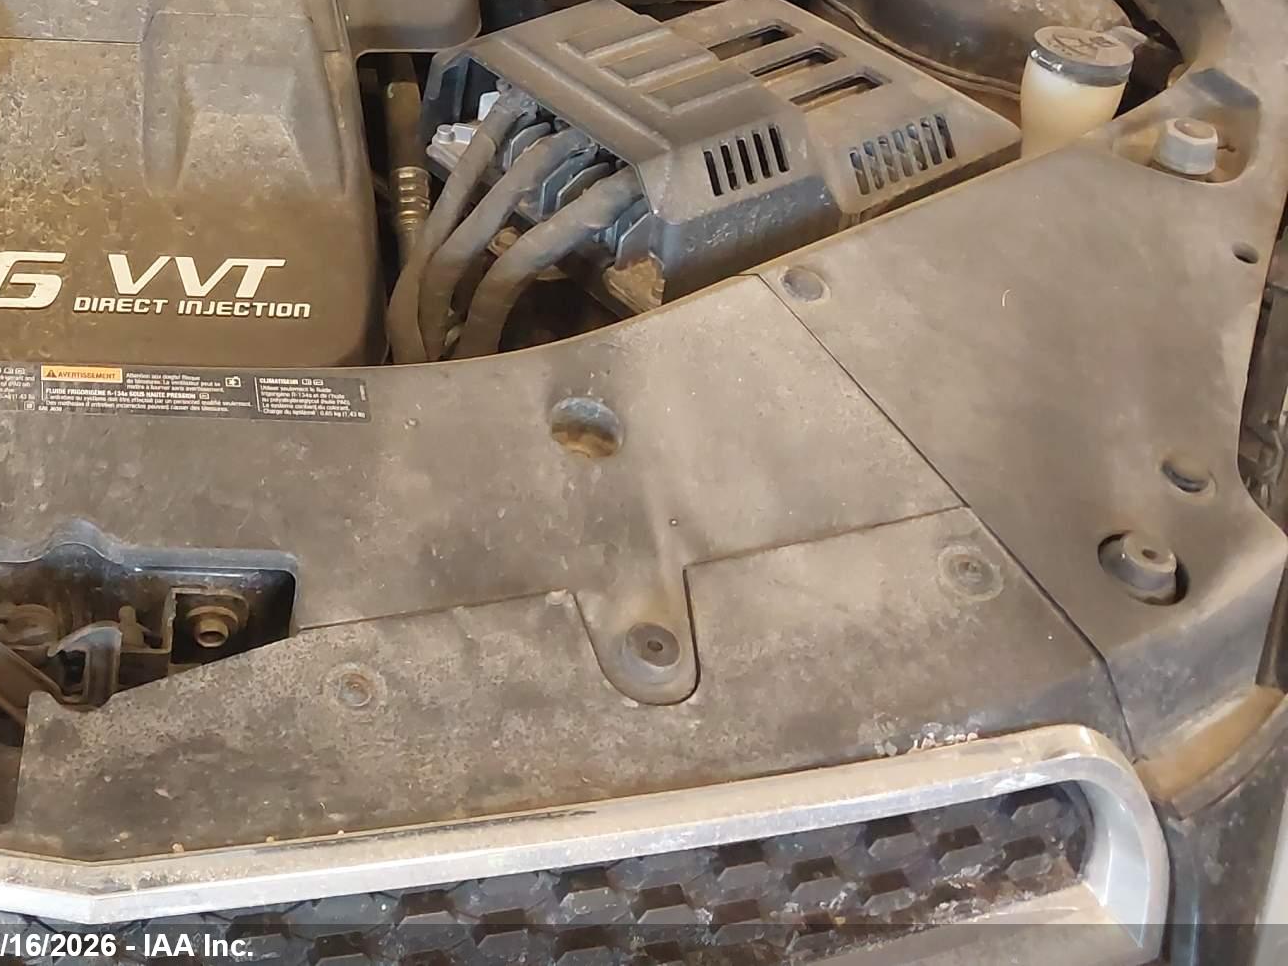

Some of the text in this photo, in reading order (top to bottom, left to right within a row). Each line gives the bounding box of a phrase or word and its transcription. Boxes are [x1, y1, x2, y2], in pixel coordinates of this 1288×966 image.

[108, 254, 286, 299] VVT
[73, 296, 310, 318] DIRECT INJECTION
[58, 371, 116, 379] AVERTISSEMENT
